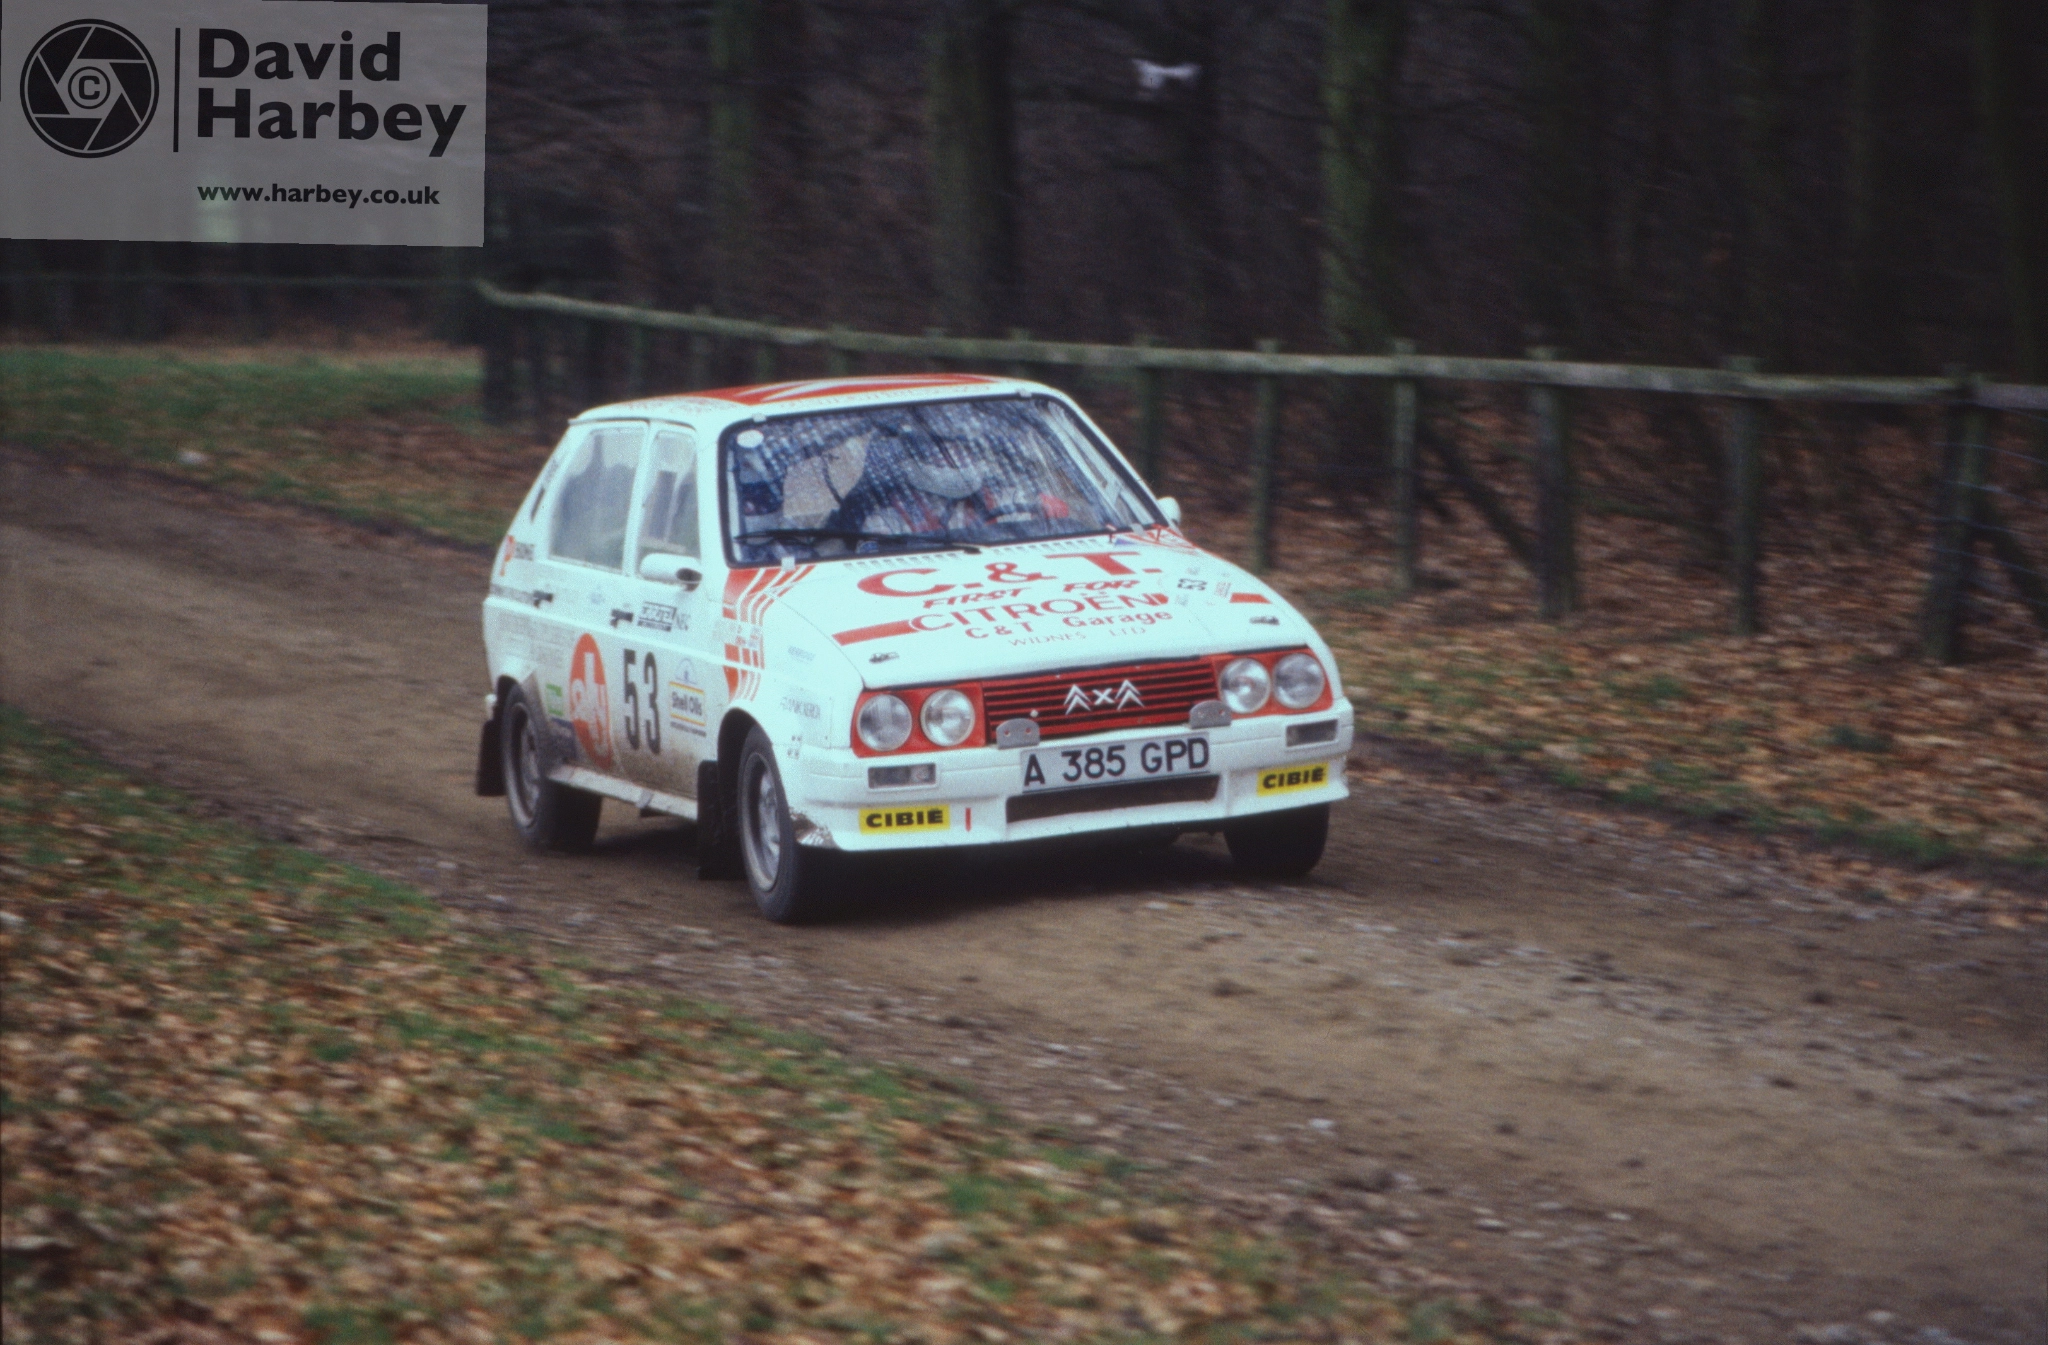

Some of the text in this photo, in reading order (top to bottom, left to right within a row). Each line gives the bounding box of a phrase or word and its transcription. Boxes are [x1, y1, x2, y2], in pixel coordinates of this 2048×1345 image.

[922, 578, 1141, 610] FIRST FOR
[1062, 610, 1173, 629] Garage
[1007, 631, 1087, 647] WIDNES
[622, 647, 661, 755] 53
[1023, 737, 1210, 788] A 385 GPD
